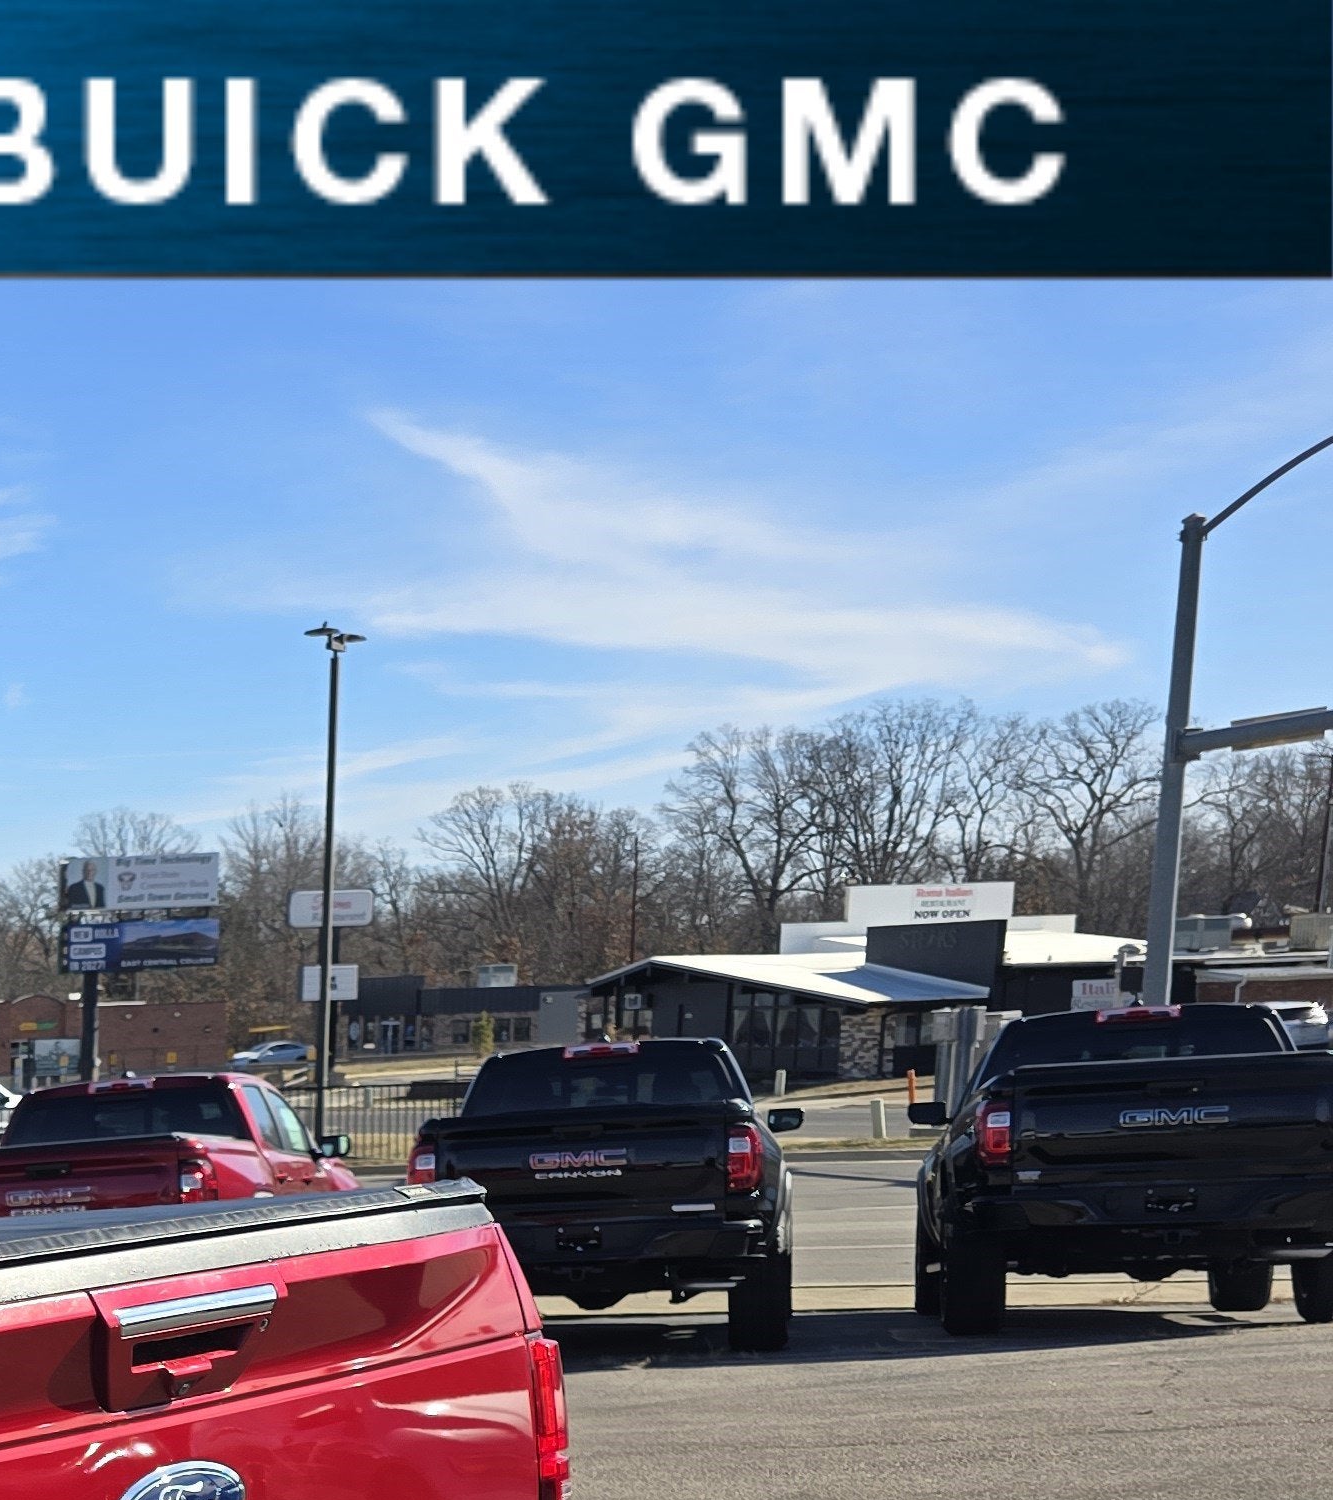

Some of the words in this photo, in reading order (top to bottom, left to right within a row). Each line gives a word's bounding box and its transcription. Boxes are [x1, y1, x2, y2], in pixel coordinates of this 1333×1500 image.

[914, 910, 939, 919] NOW
[942, 909, 971, 918] OPEN
[1119, 1104, 1230, 1128] GMC
[528, 1148, 628, 1170] GMC
[534, 1168, 623, 1180] CANYON
[5, 1186, 93, 1207] GMC
